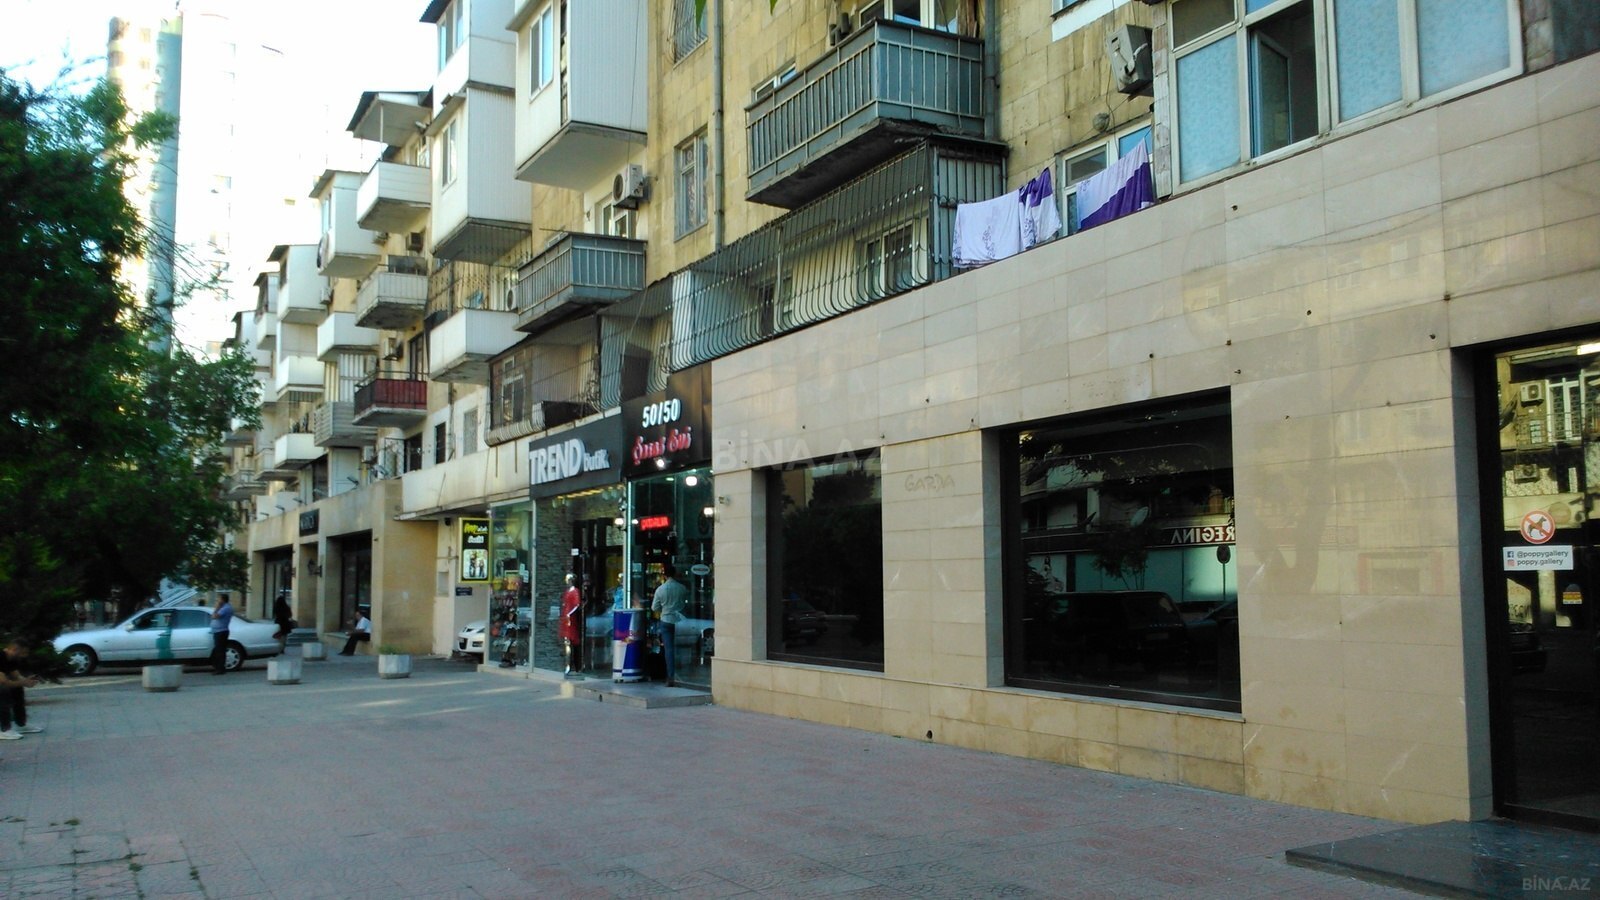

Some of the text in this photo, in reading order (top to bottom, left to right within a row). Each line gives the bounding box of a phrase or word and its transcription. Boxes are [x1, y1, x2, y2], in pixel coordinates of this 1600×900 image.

[642, 398, 681, 428] 50/50
[529, 438, 585, 485] TREND
[1517, 550, 1568, 559] @poppygallery
[1517, 558, 1564, 566] poppy.gallery
